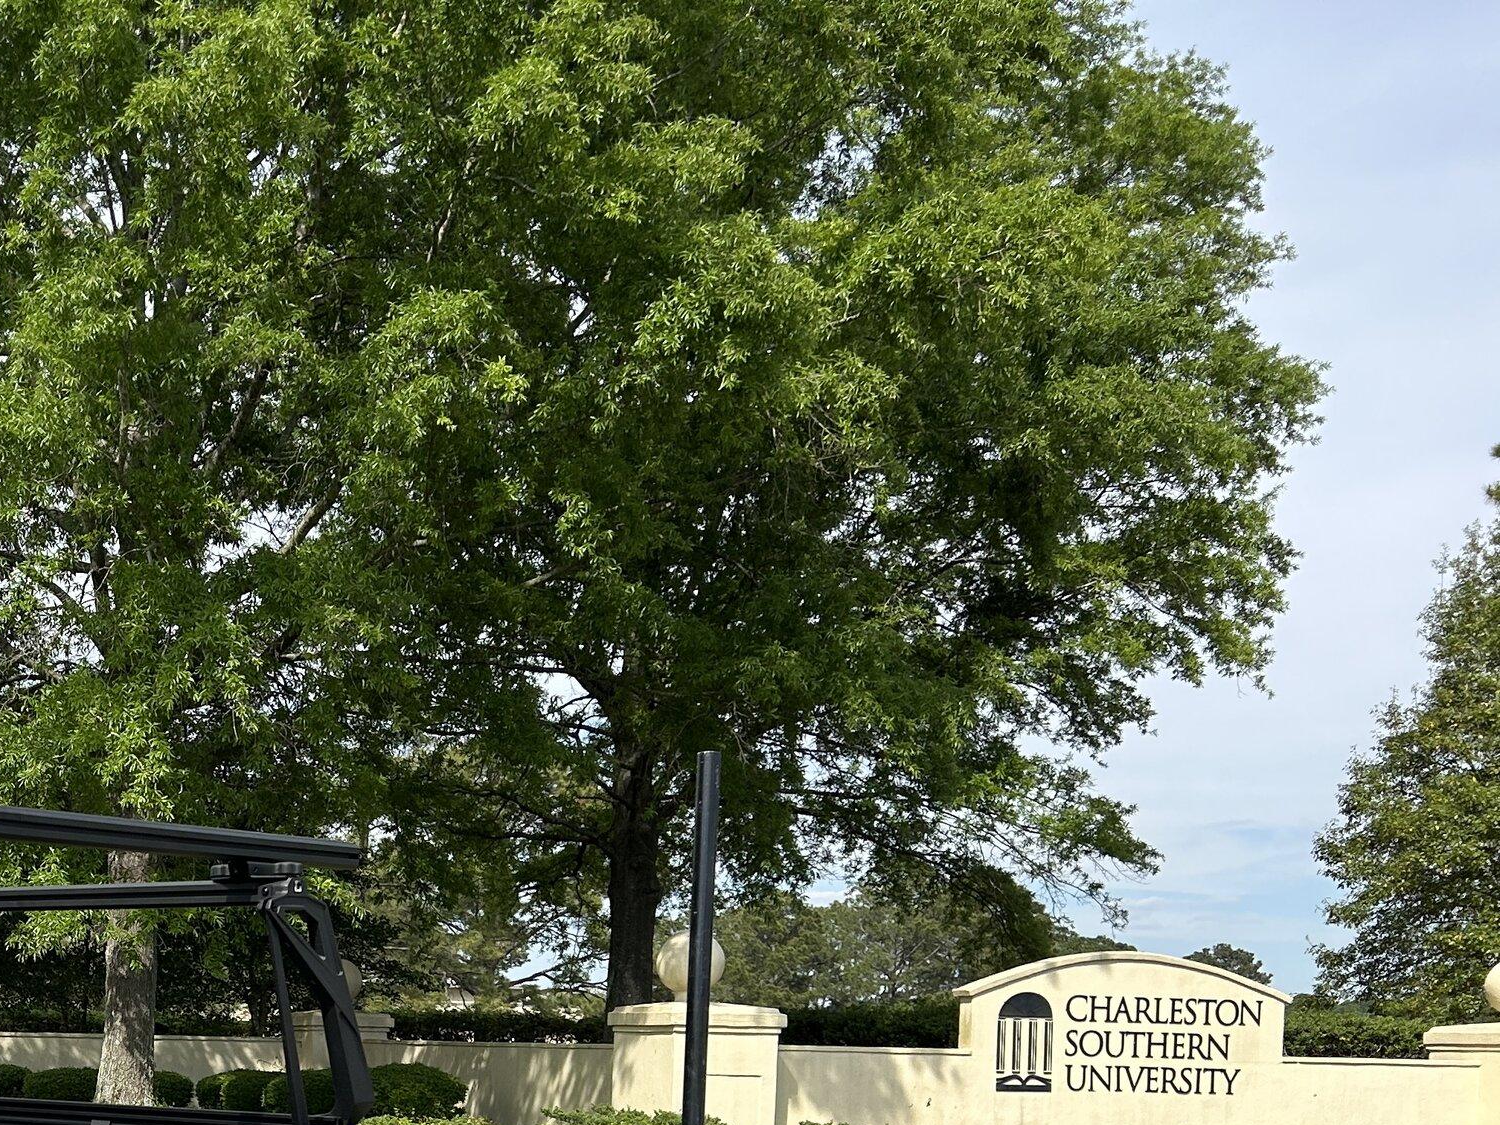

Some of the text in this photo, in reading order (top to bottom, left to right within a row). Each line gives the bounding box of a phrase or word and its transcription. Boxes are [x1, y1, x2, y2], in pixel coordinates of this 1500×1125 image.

[1065, 994, 1263, 1027] CHARLESTON
[1065, 1029, 1231, 1061] SOUTHERN
[1065, 1064, 1241, 1096] UNIVERSITY
